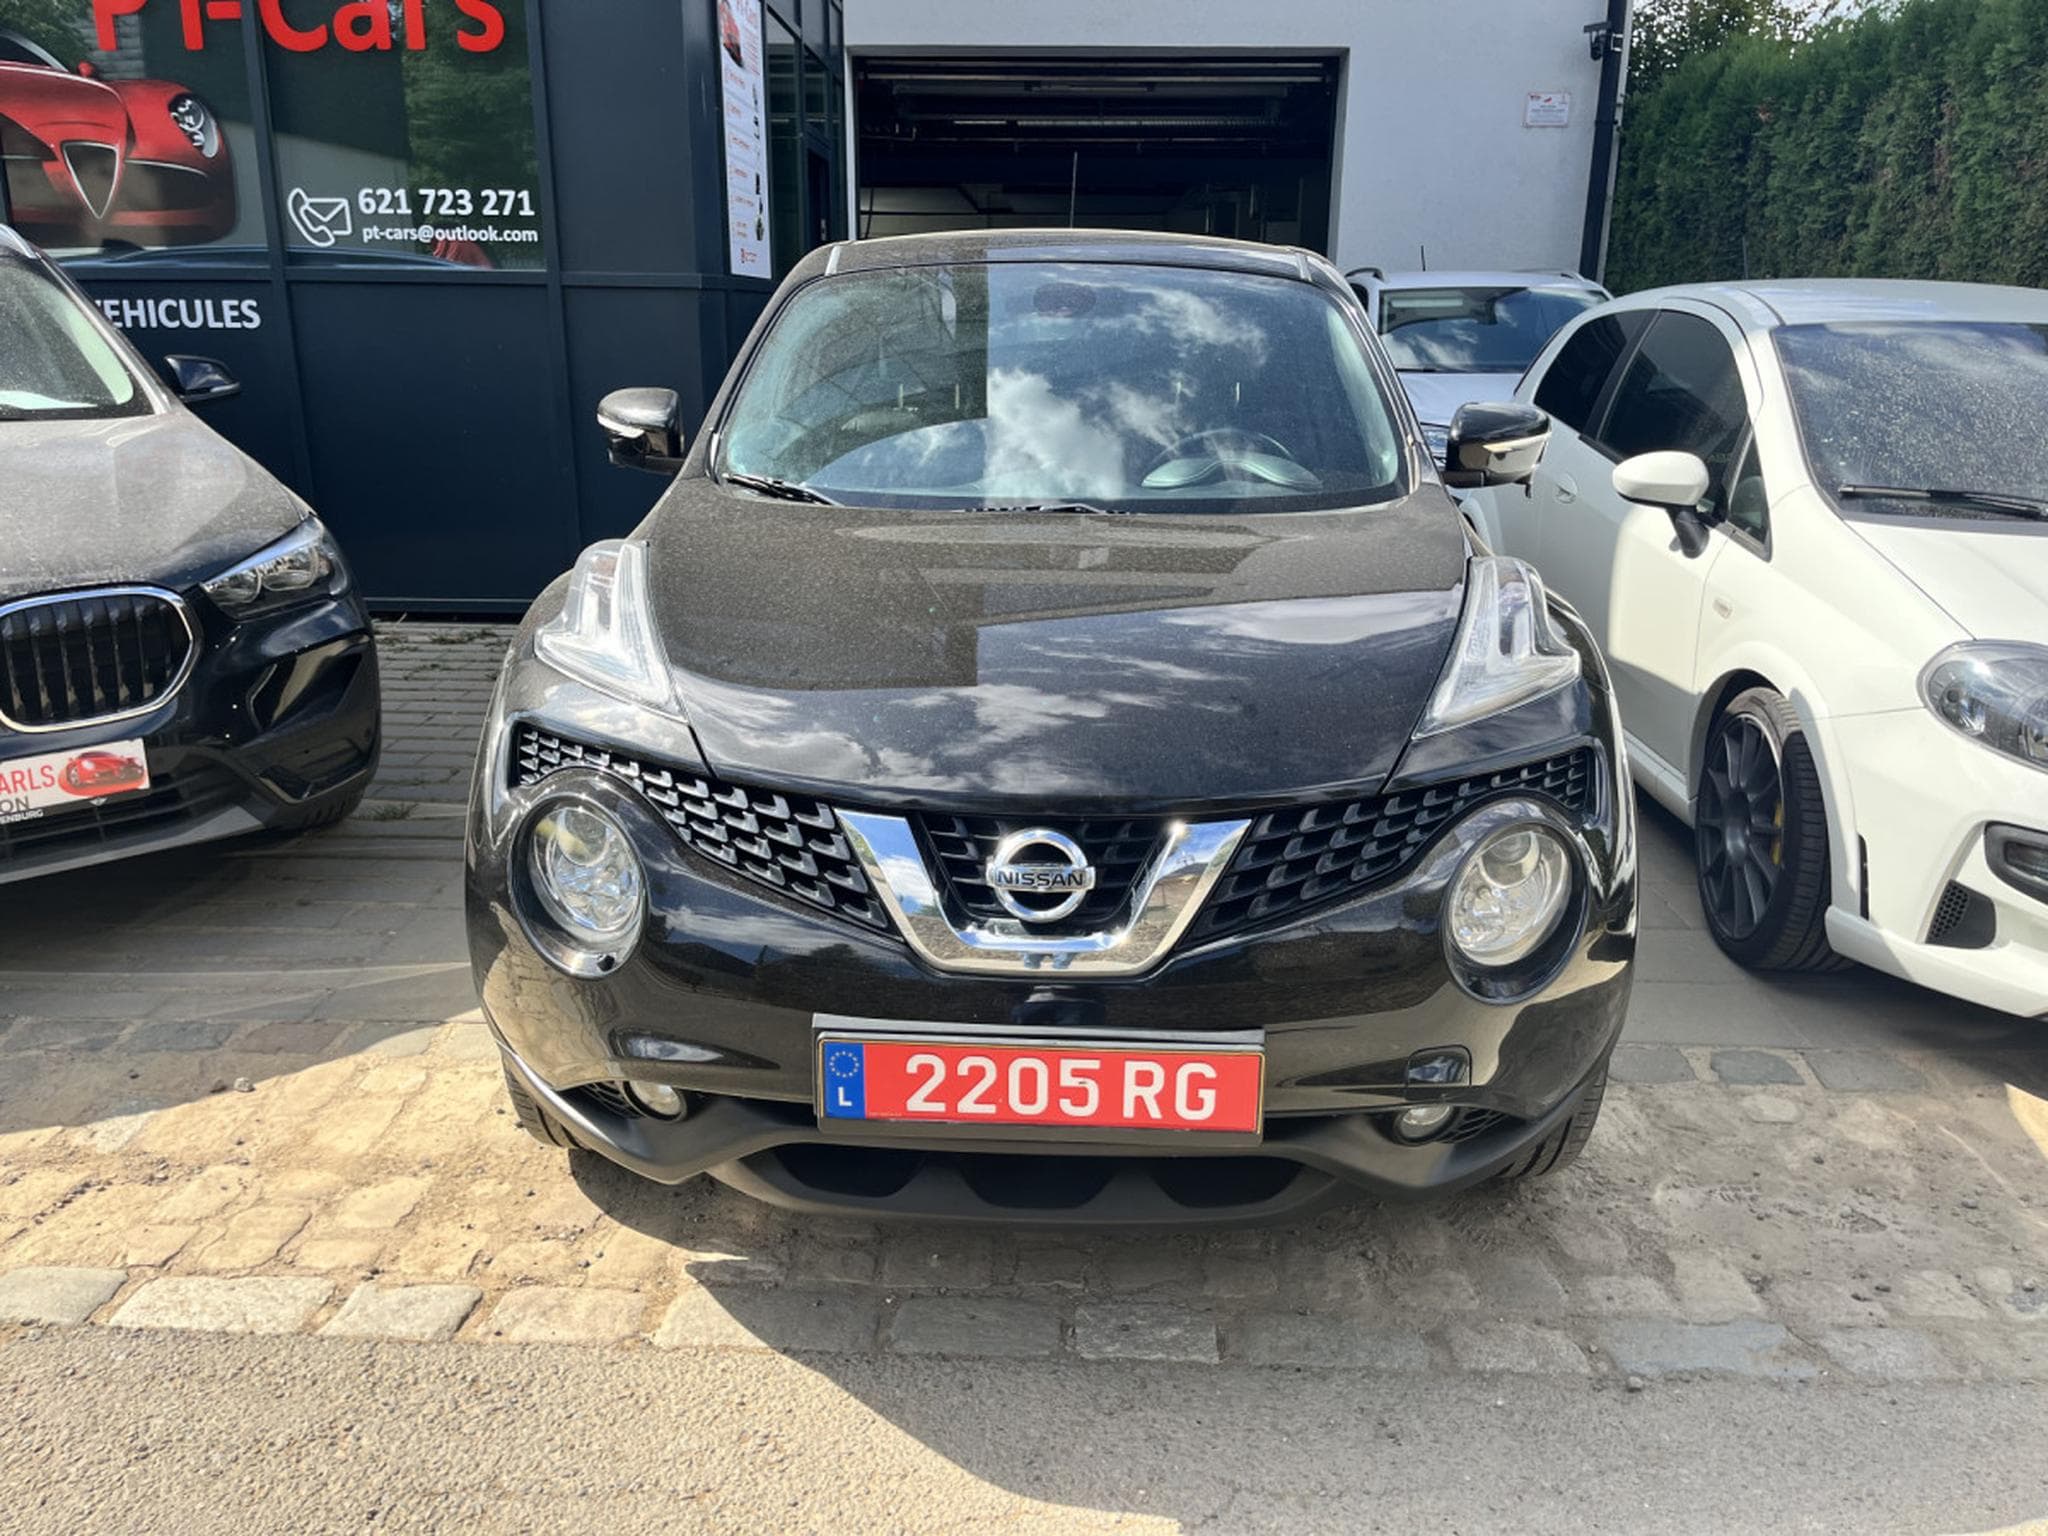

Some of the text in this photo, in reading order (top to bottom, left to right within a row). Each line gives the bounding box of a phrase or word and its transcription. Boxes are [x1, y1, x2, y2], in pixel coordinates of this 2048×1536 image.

[357, 187, 536, 217] 621 723 271
[362, 224, 539, 244] pt-cars@outlook.com
[997, 869, 1084, 888] NISSAN
[837, 1086, 853, 1107] L
[905, 1053, 1218, 1121] 2205 RG
